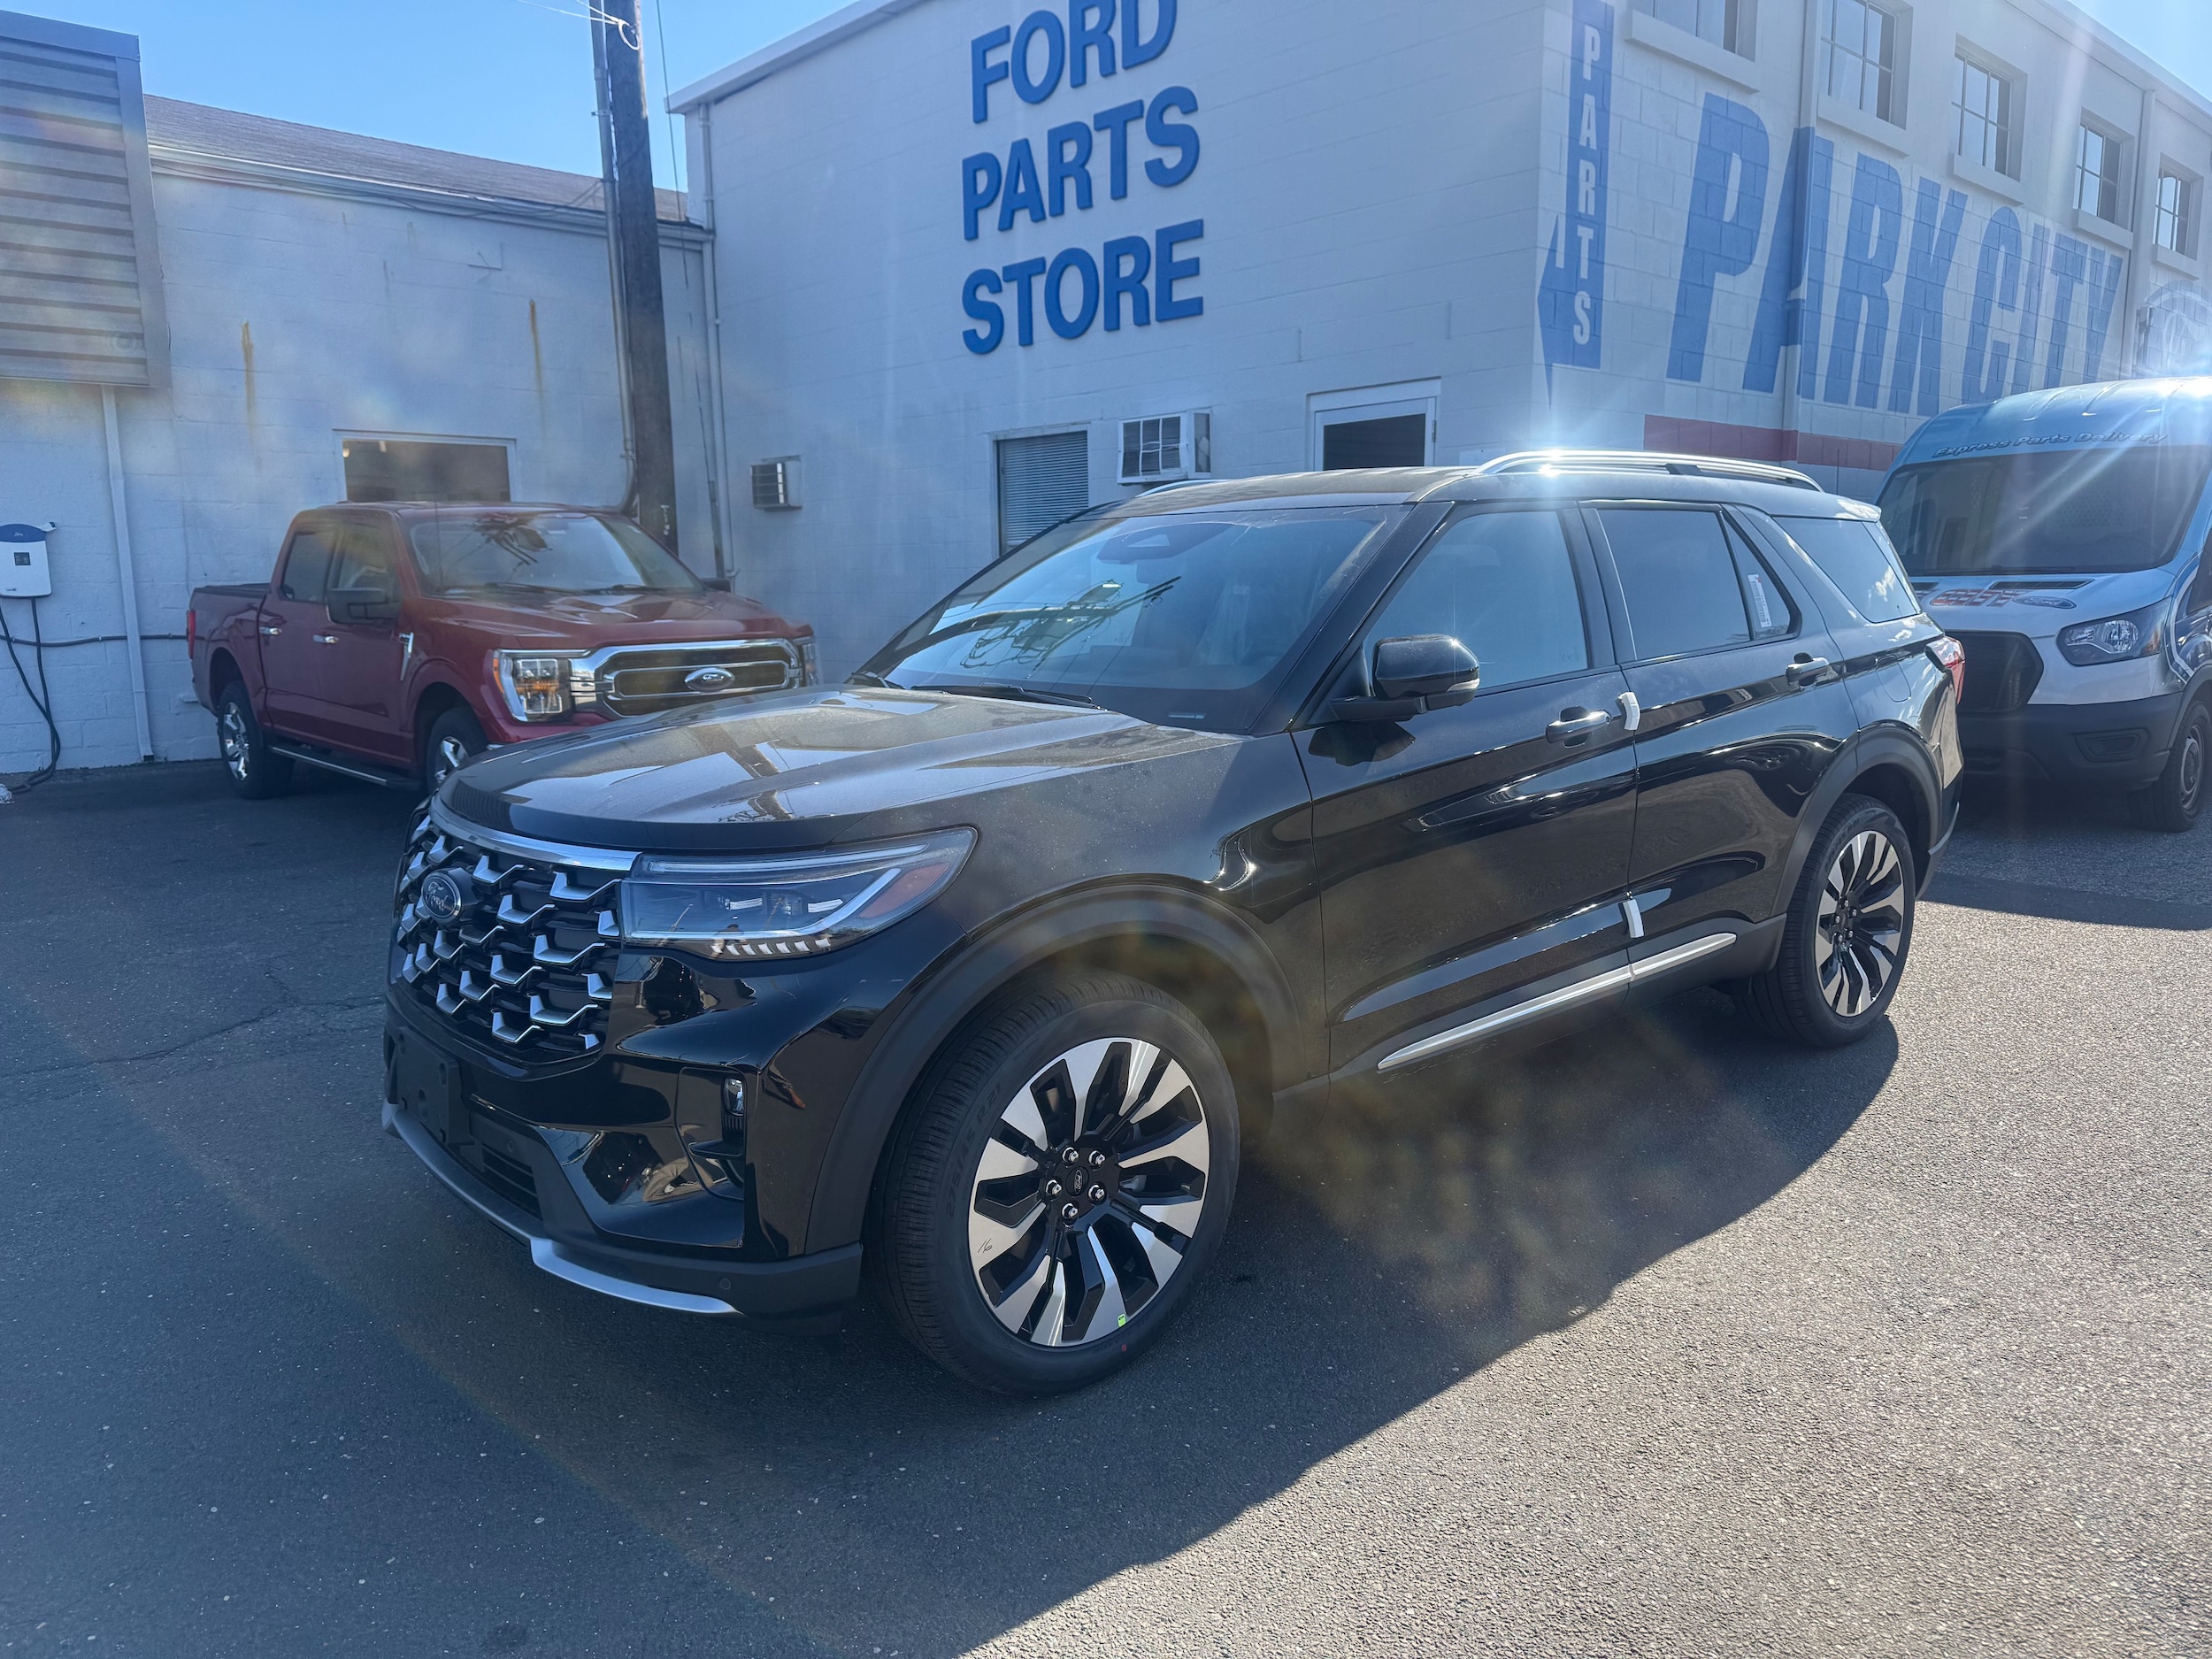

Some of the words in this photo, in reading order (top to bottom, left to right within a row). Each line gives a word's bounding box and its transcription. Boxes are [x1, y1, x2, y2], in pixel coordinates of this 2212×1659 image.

[971, 0, 1178, 124] FORD
[962, 86, 1200, 241] PARTS
[1571, 25, 1601, 345] PARTS
[962, 219, 1203, 355] STORE
[1666, 91, 1968, 416] PARK
[1962, 206, 2123, 403] CITY
[1932, 439, 2011, 458] Express
[2013, 433, 2071, 446] Parts
[2074, 431, 2169, 444] Delivery
